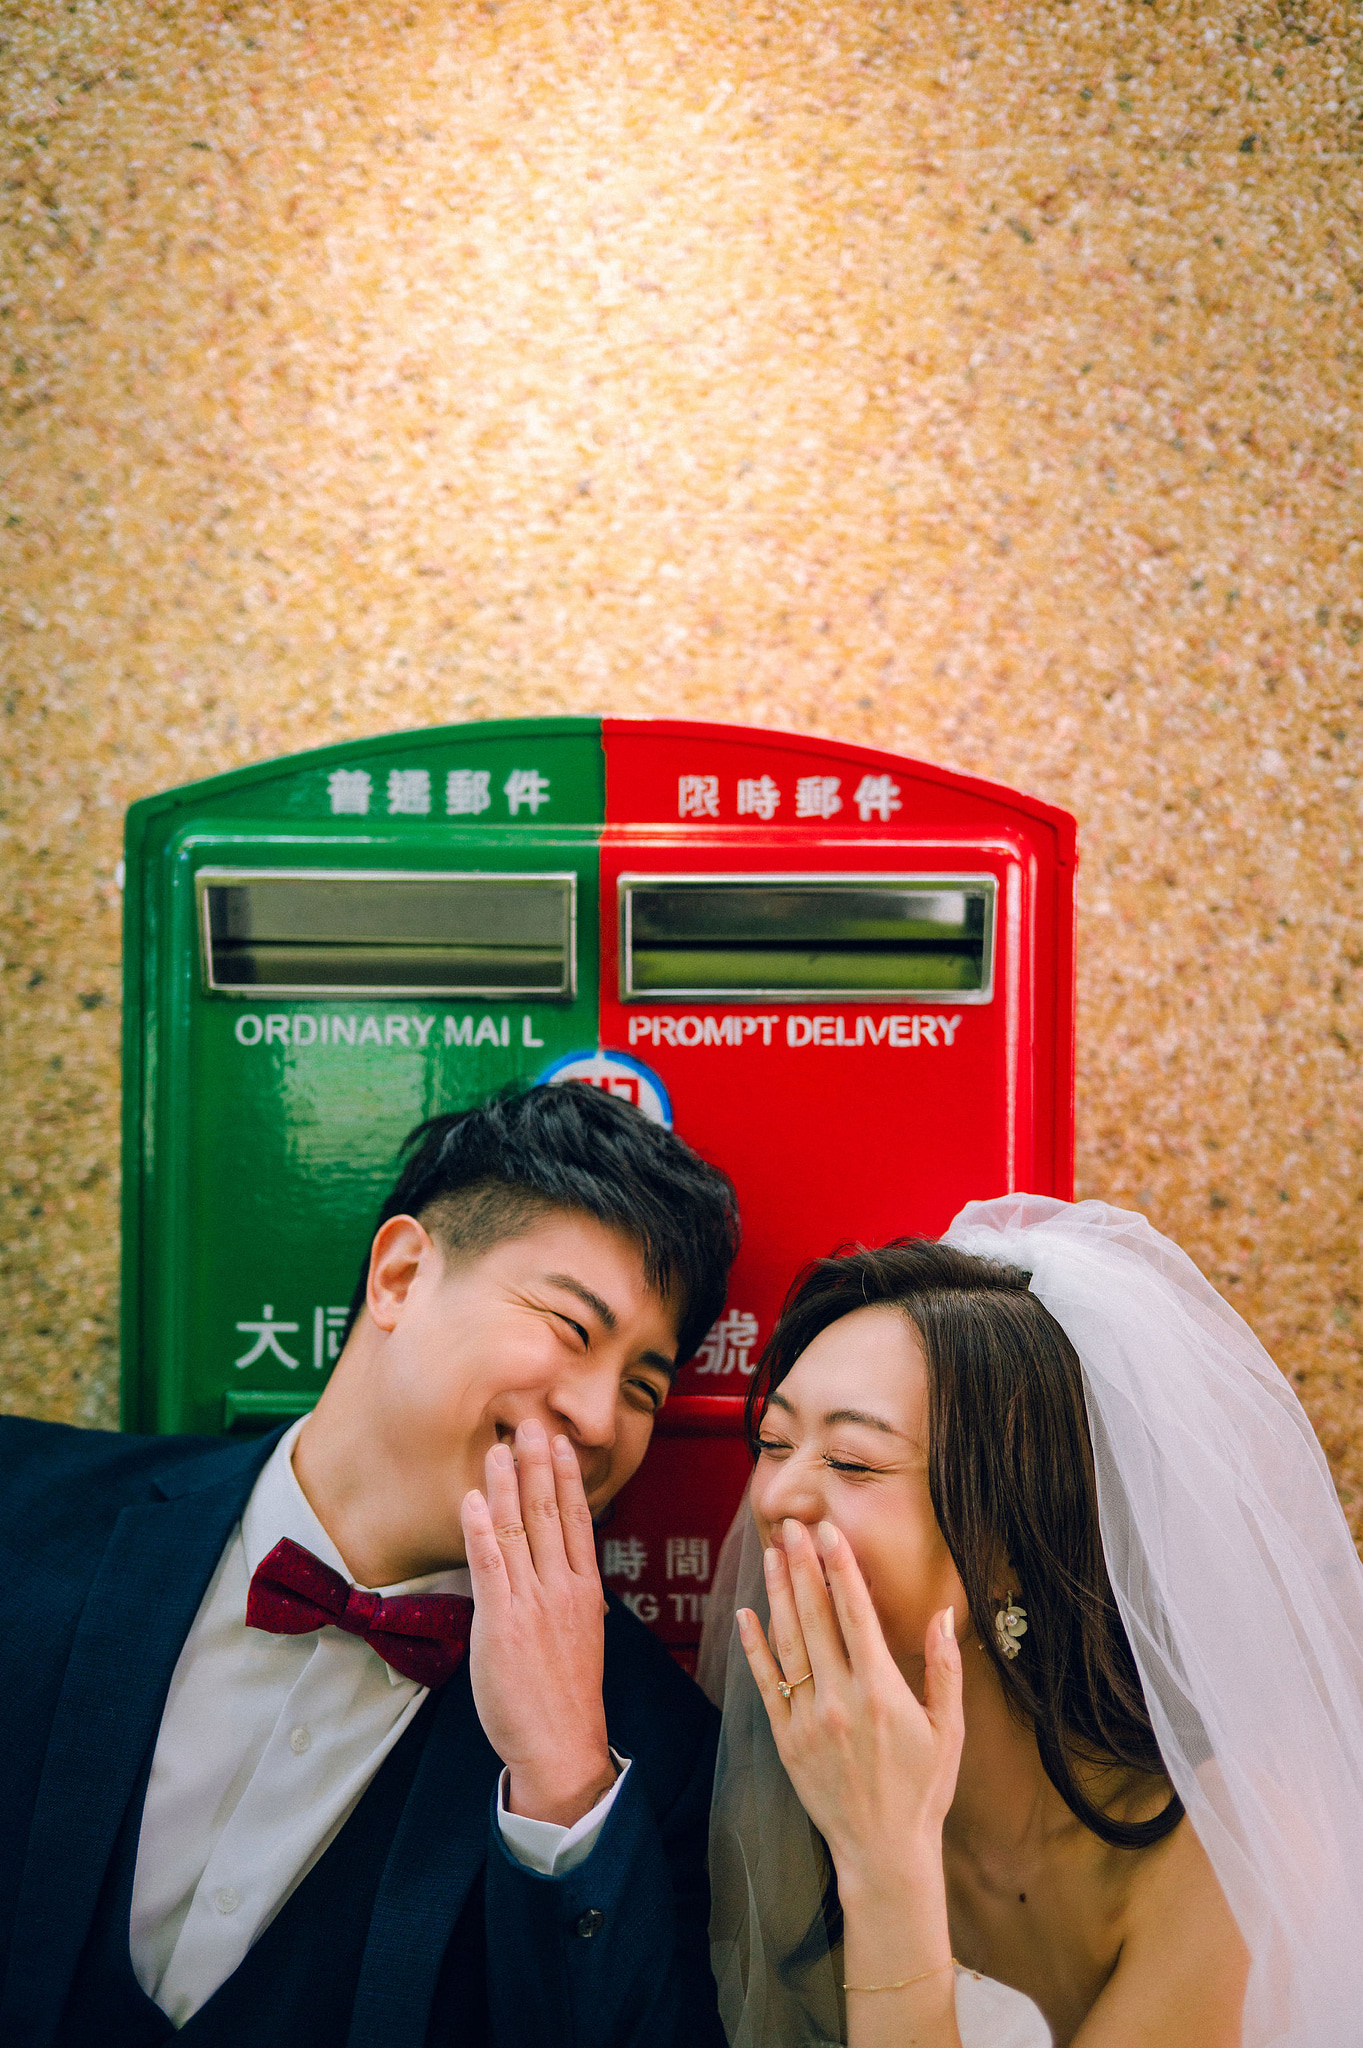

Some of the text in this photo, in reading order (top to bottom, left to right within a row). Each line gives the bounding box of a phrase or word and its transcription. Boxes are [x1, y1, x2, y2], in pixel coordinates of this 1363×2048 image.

[327, 769, 550, 815] 普通郵件
[678, 775, 902, 822] 限時郵件
[235, 1015, 435, 1046] ORDINARY
[628, 1015, 962, 1047] PROMPT DELIVERY
